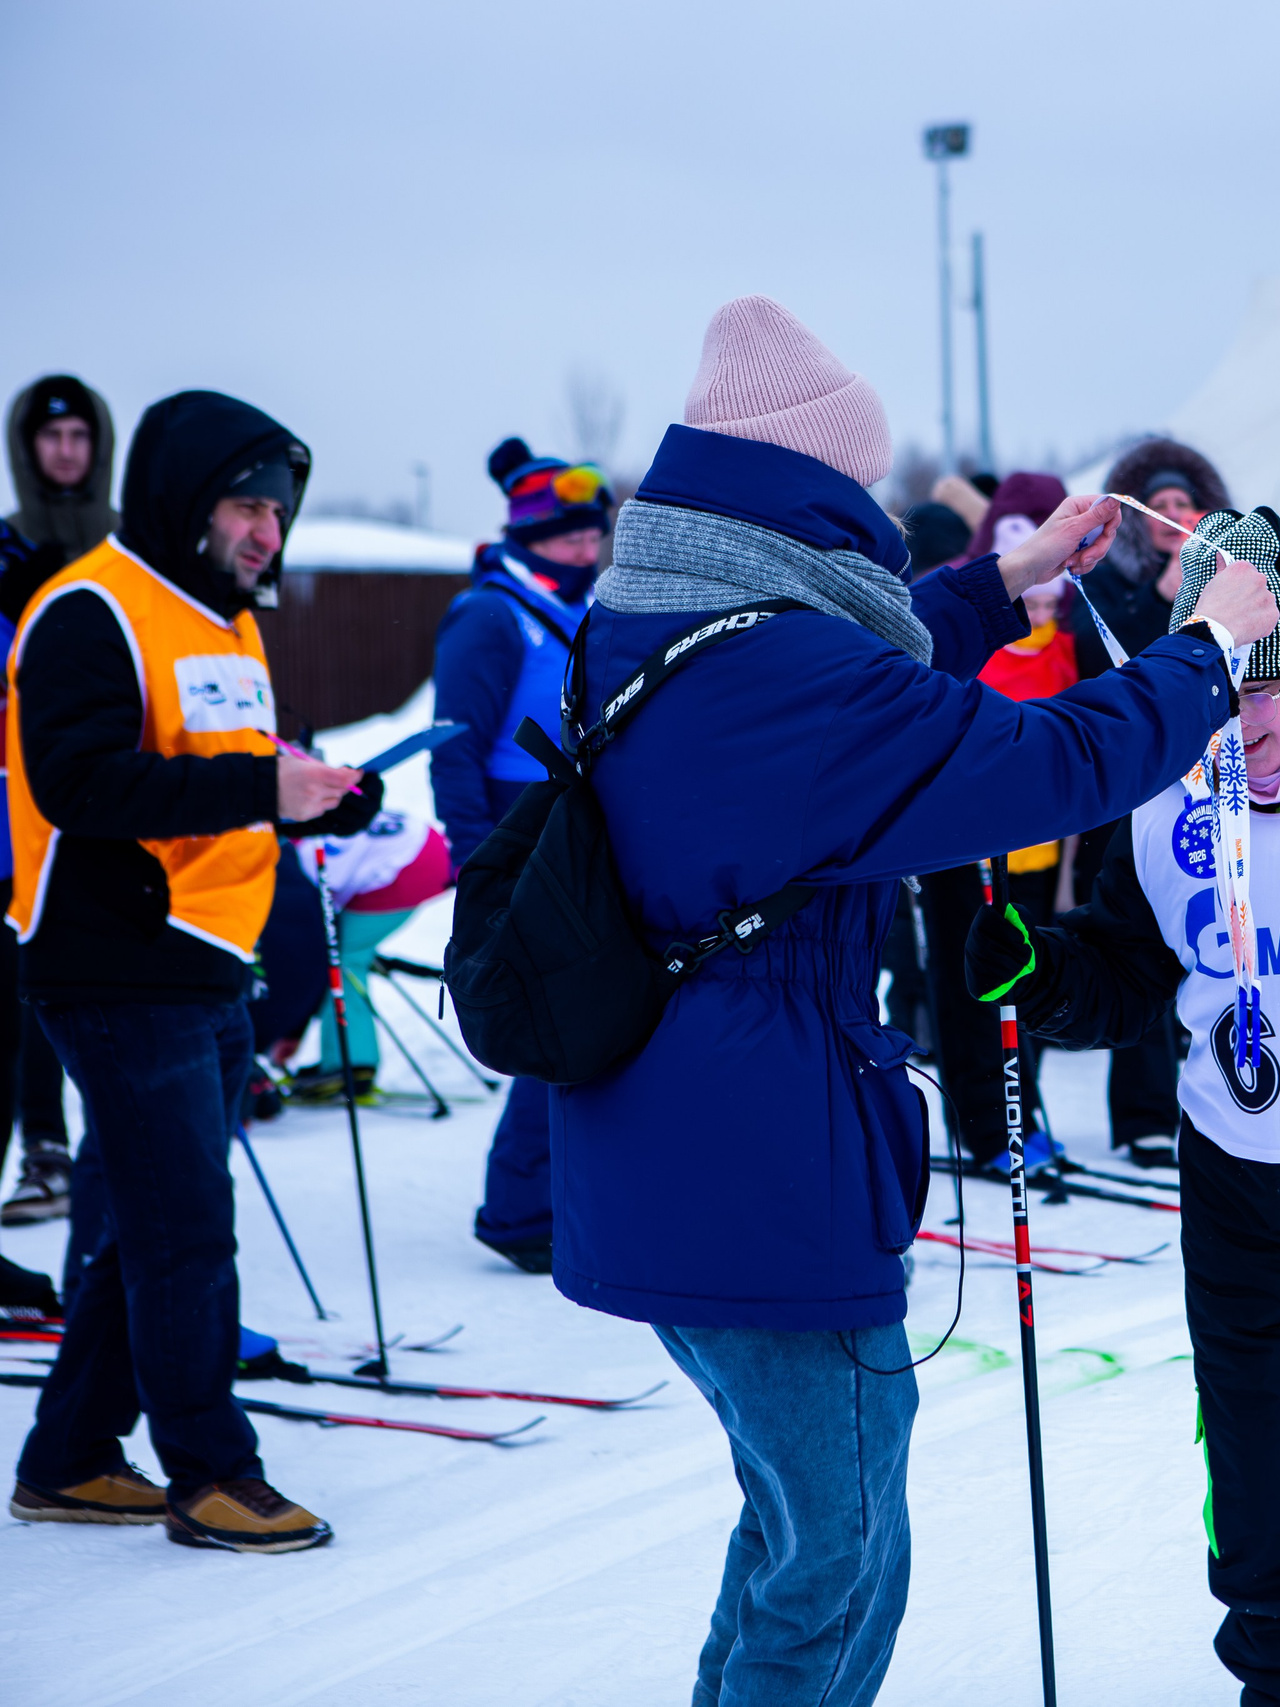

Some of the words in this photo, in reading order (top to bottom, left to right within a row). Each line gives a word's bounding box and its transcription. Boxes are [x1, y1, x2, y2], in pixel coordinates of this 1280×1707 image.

[1188, 849, 1207, 865] 2026
[1003, 1056, 1027, 1217] VUOKATTI
[1018, 1278, 1033, 1328] A7
